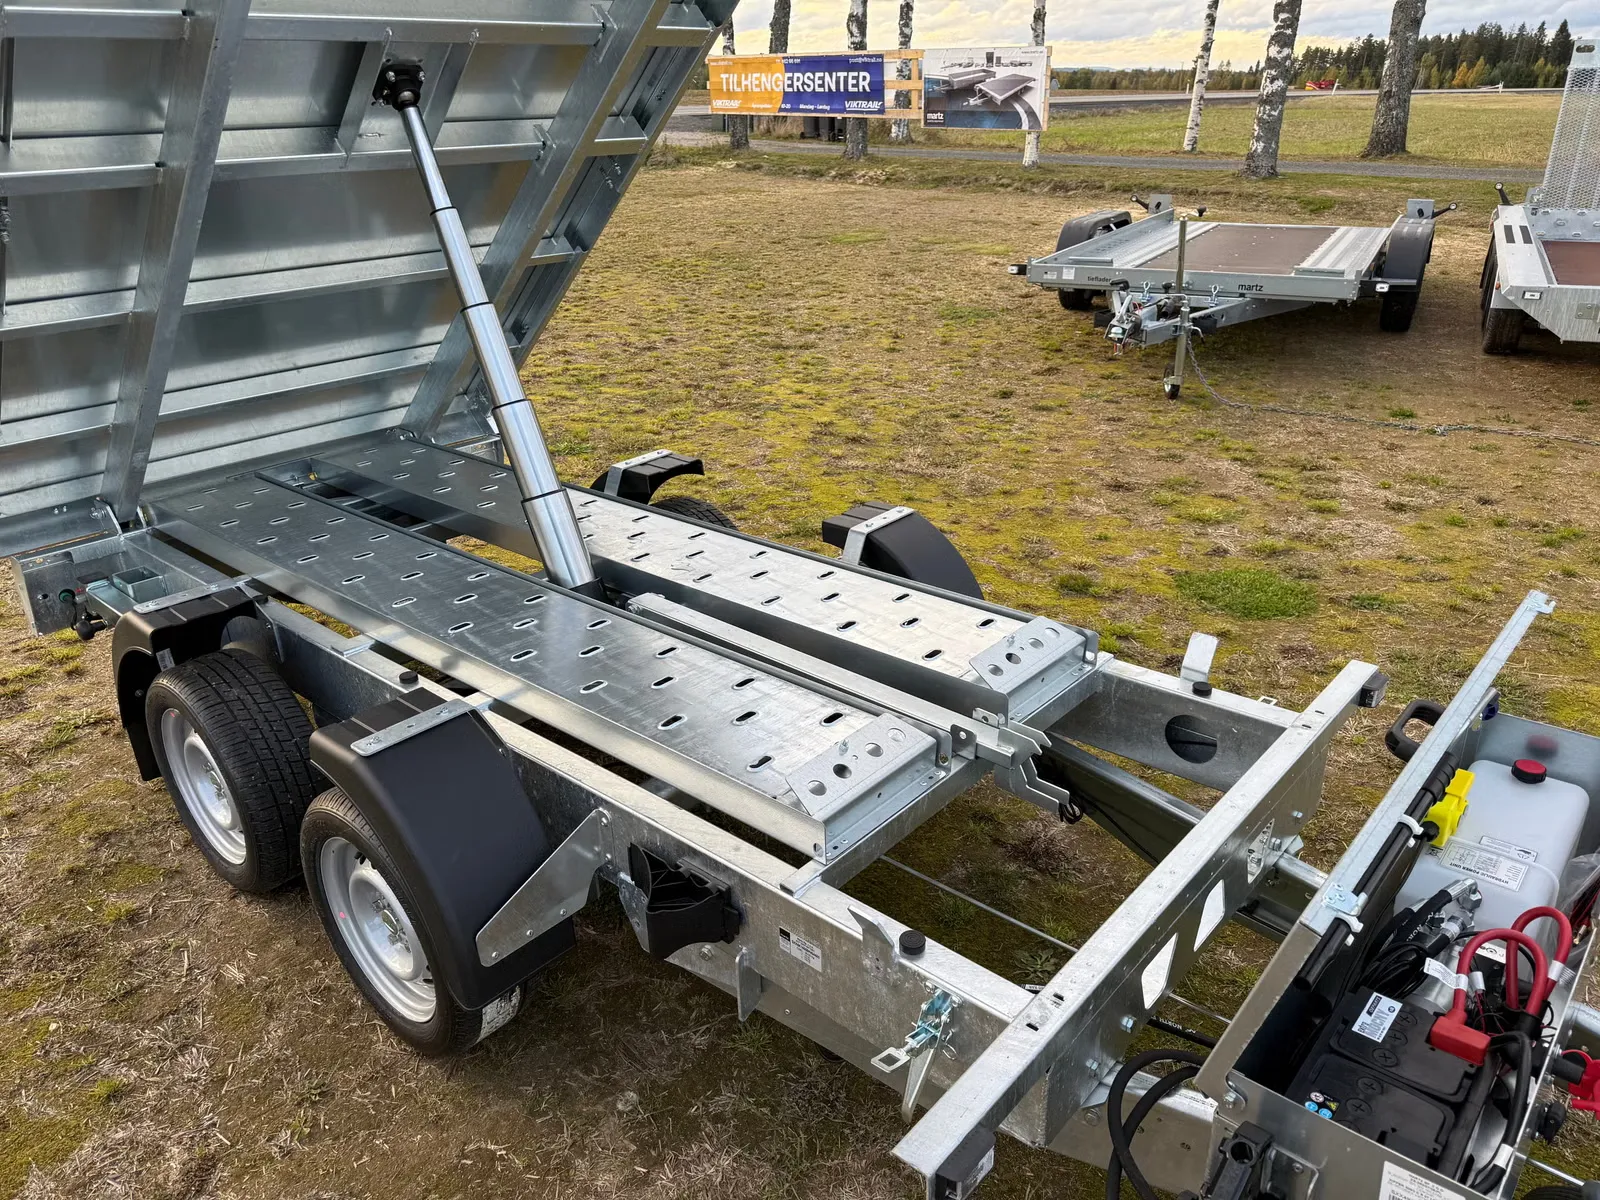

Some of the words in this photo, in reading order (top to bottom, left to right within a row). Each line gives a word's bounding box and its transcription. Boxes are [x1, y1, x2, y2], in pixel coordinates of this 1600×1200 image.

[720, 71, 871, 92] TILHENGERSENTER
[712, 100, 741, 108] VIKTRAIL
[845, 100, 883, 109] VIKTRAIL
[1462, 865, 1480, 875] POWER
[1480, 872, 1509, 885] HYDRAULIC
